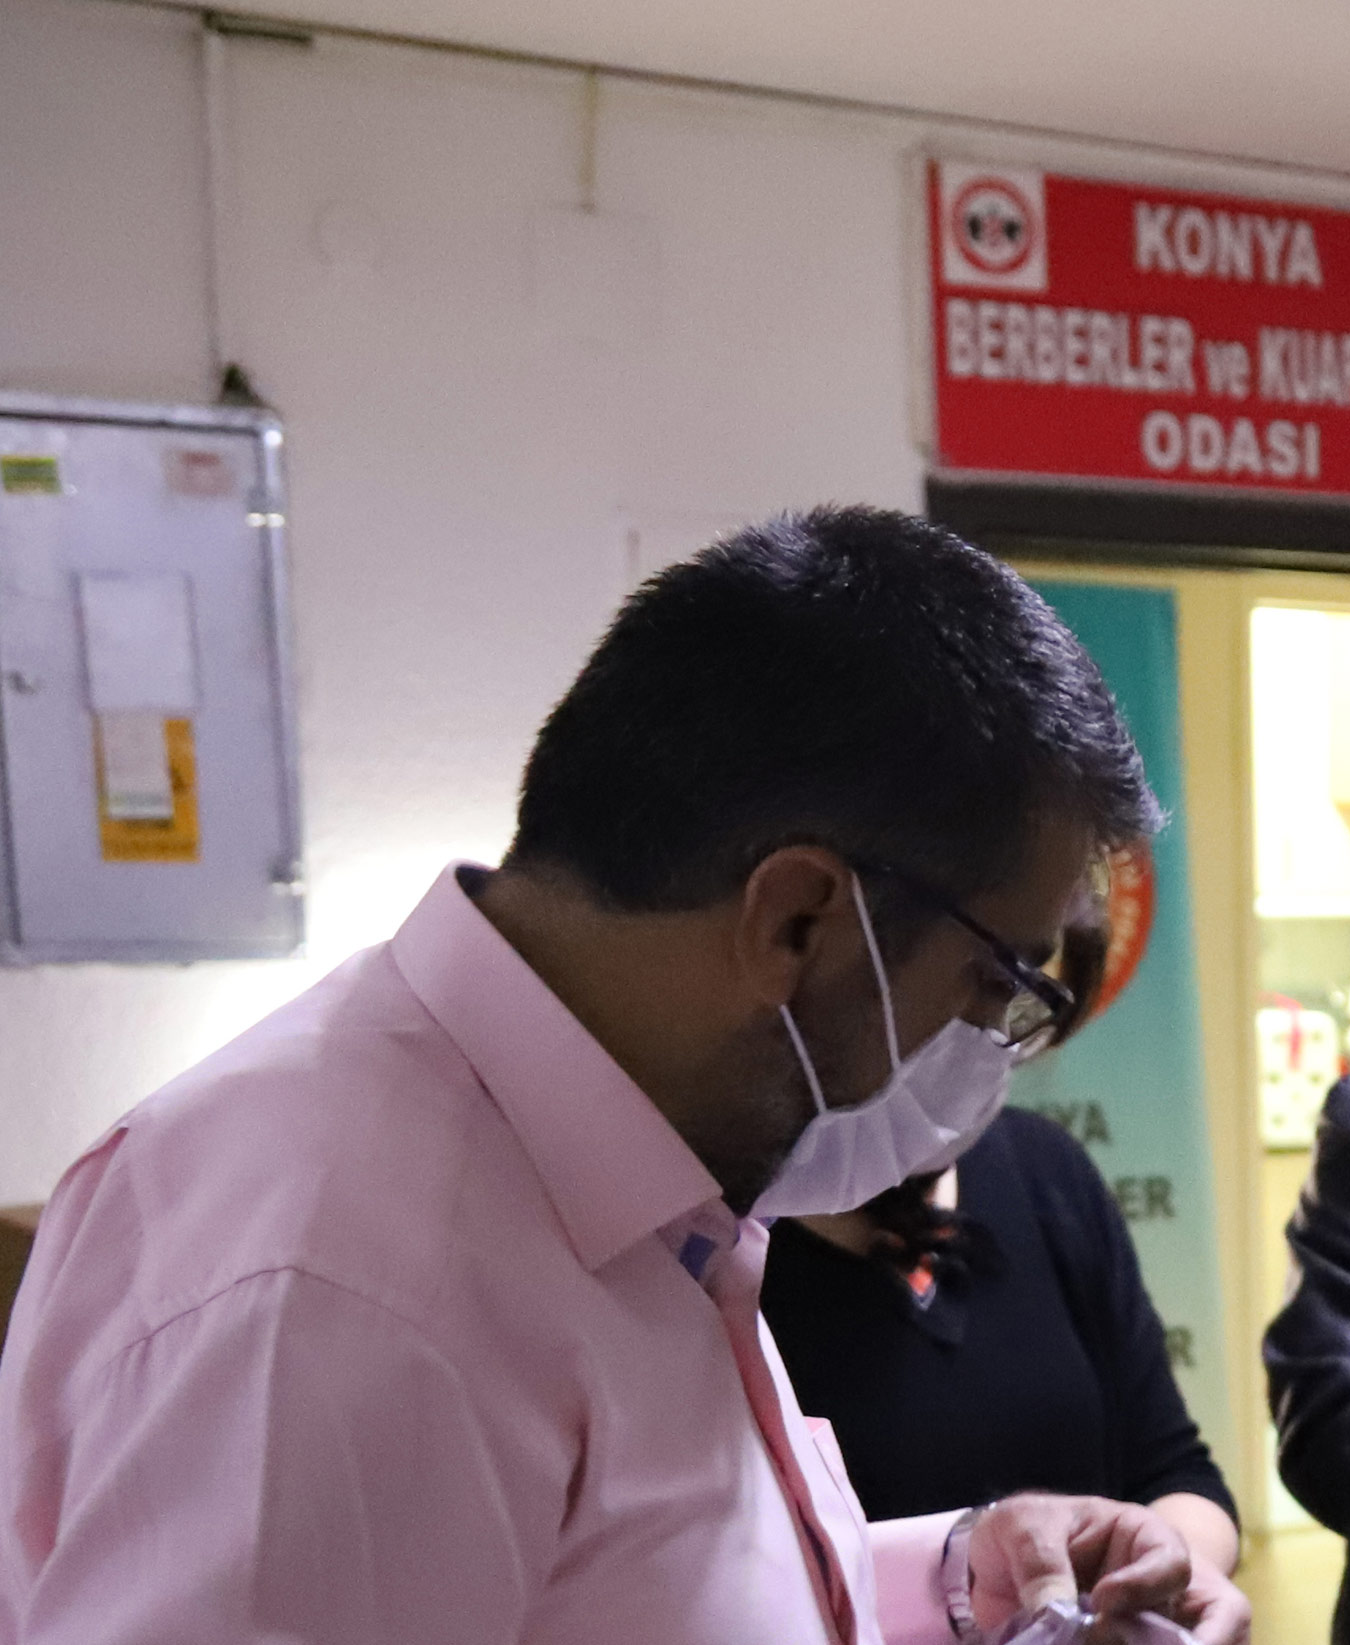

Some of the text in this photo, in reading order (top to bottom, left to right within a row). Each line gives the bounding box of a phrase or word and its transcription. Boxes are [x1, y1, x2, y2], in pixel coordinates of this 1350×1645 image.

[1134, 204, 1322, 288] KONYA
[946, 299, 1193, 392] BERBERLER
[1203, 342, 1249, 396] ve
[1142, 411, 1319, 477] ODASI
